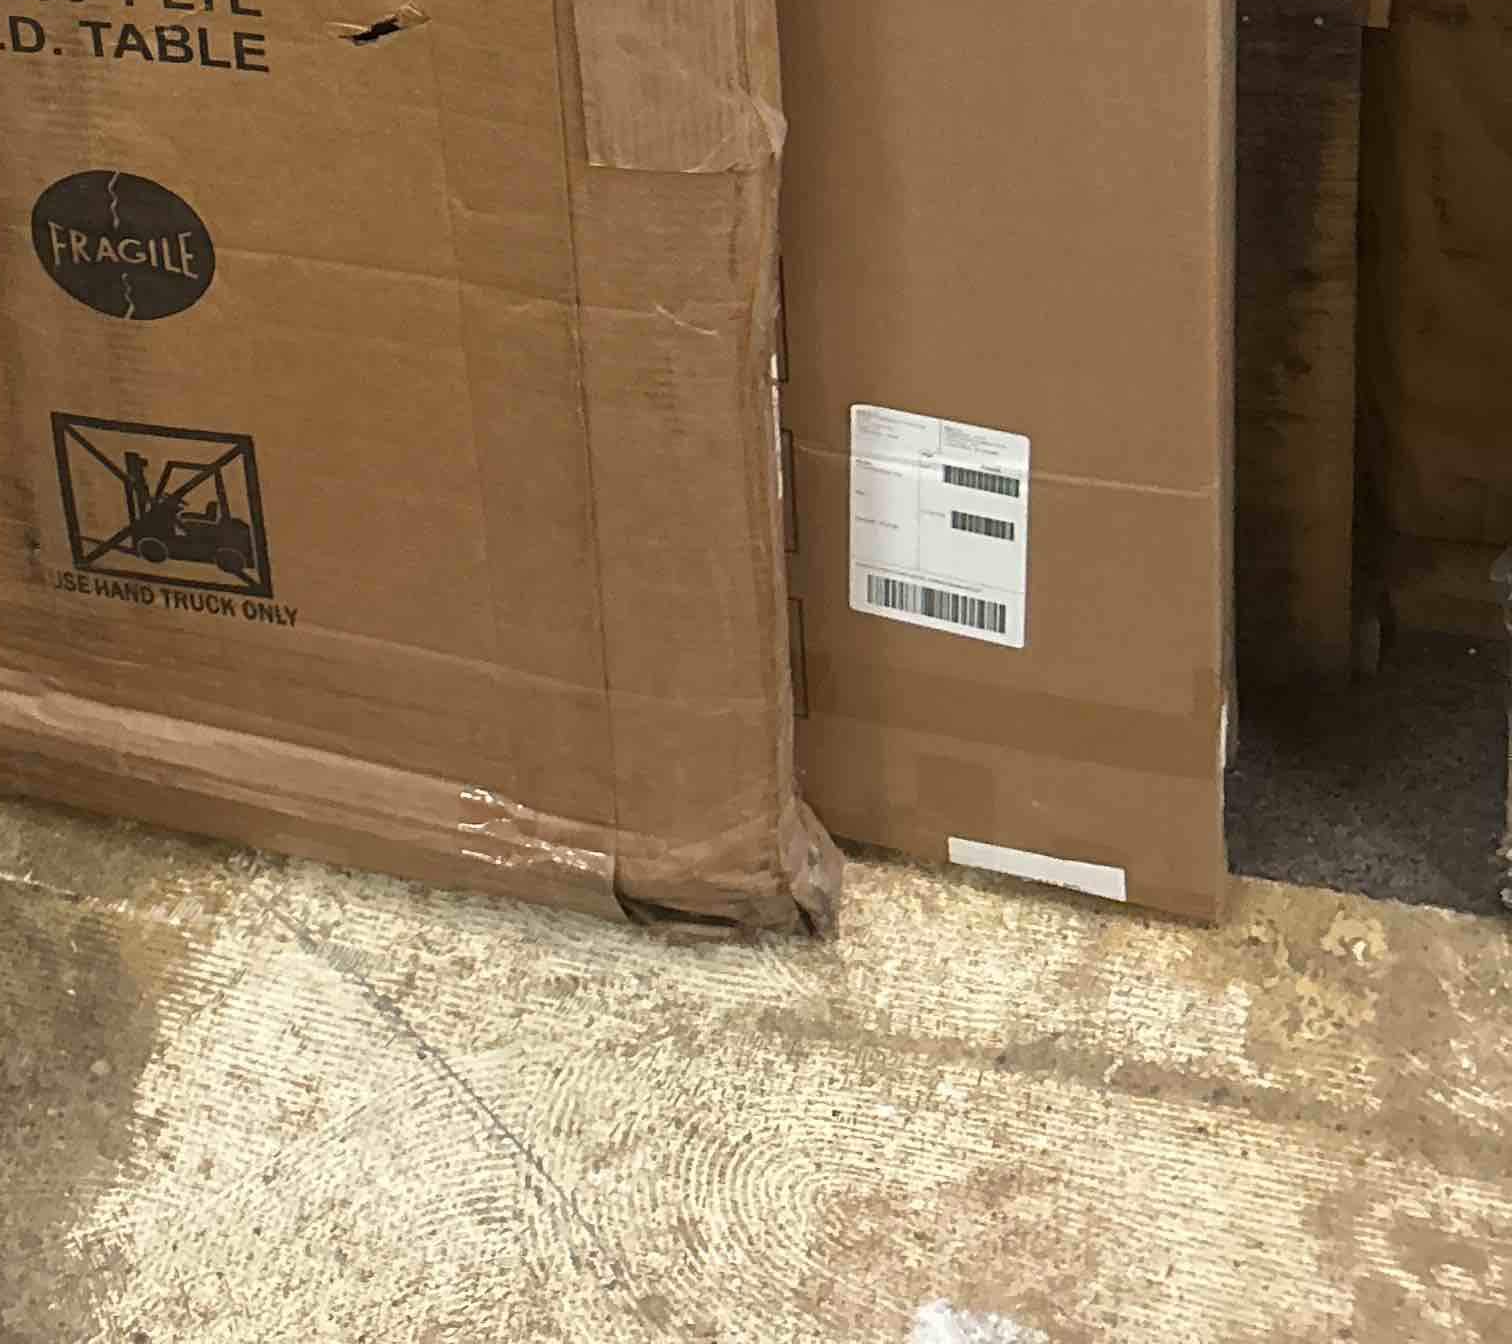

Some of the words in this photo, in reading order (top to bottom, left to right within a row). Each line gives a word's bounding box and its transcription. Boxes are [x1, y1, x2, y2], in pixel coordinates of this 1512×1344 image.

[79, 19, 271, 73] TABLE
[47, 220, 199, 280] FRAGILE
[92, 574, 156, 606] HAND
[158, 587, 237, 617] TRUCK
[240, 598, 299, 629] ONLY
